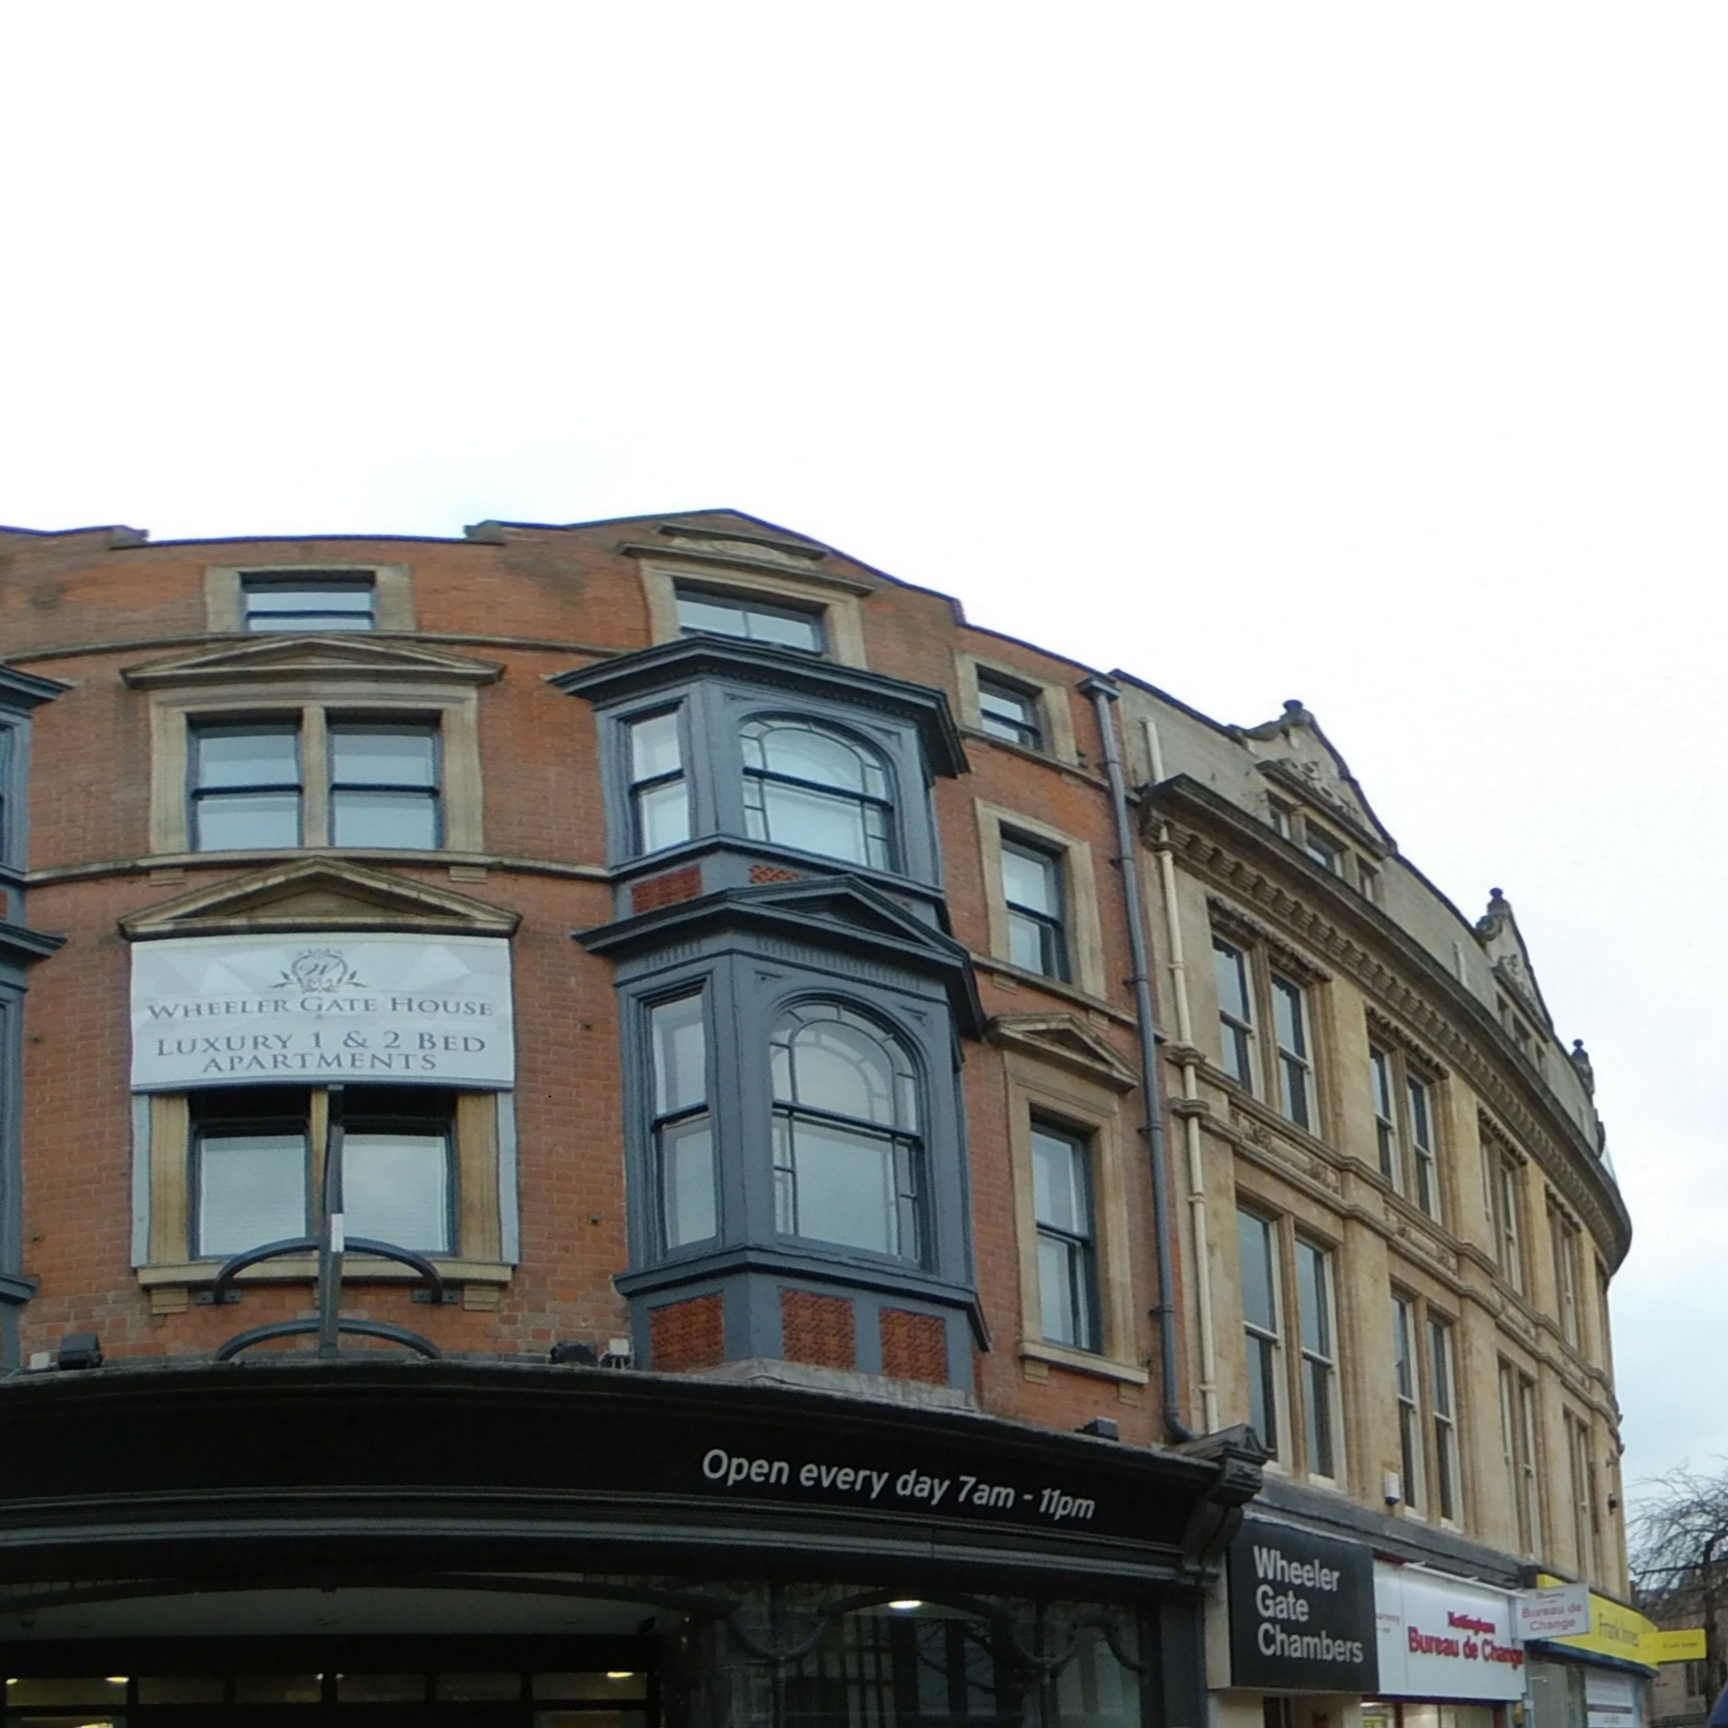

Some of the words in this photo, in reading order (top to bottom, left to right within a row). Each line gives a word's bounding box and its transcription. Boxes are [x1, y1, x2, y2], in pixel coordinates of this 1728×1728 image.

[147, 998, 289, 1021] WHEELER
[299, 995, 377, 1015] GATE
[390, 996, 494, 1017] HOUSE
[156, 1032, 295, 1057] LUXURY
[311, 1031, 323, 1049] 1
[342, 1030, 370, 1049] &
[382, 1030, 402, 1050] 2
[417, 1032, 487, 1053] BED
[202, 1052, 438, 1074] APARTMENTS
[702, 1448, 790, 1487] Open
[799, 1462, 890, 1499] every
[896, 1468, 951, 1506] day
[957, 1474, 1016, 1509] 7am
[1038, 1487, 1097, 1521] 11pm
[1253, 1544, 1341, 1592] Wheeler
[1256, 1583, 1310, 1622] Gate
[1521, 1605, 1565, 1619] Bureau
[1567, 1602, 1583, 1613] de
[1529, 1618, 1576, 1632] Change
[1257, 1621, 1365, 1664] Chambers
[1407, 1625, 1460, 1658] Bureau
[1463, 1634, 1479, 1661] de
[1481, 1638, 1525, 1671] Change
